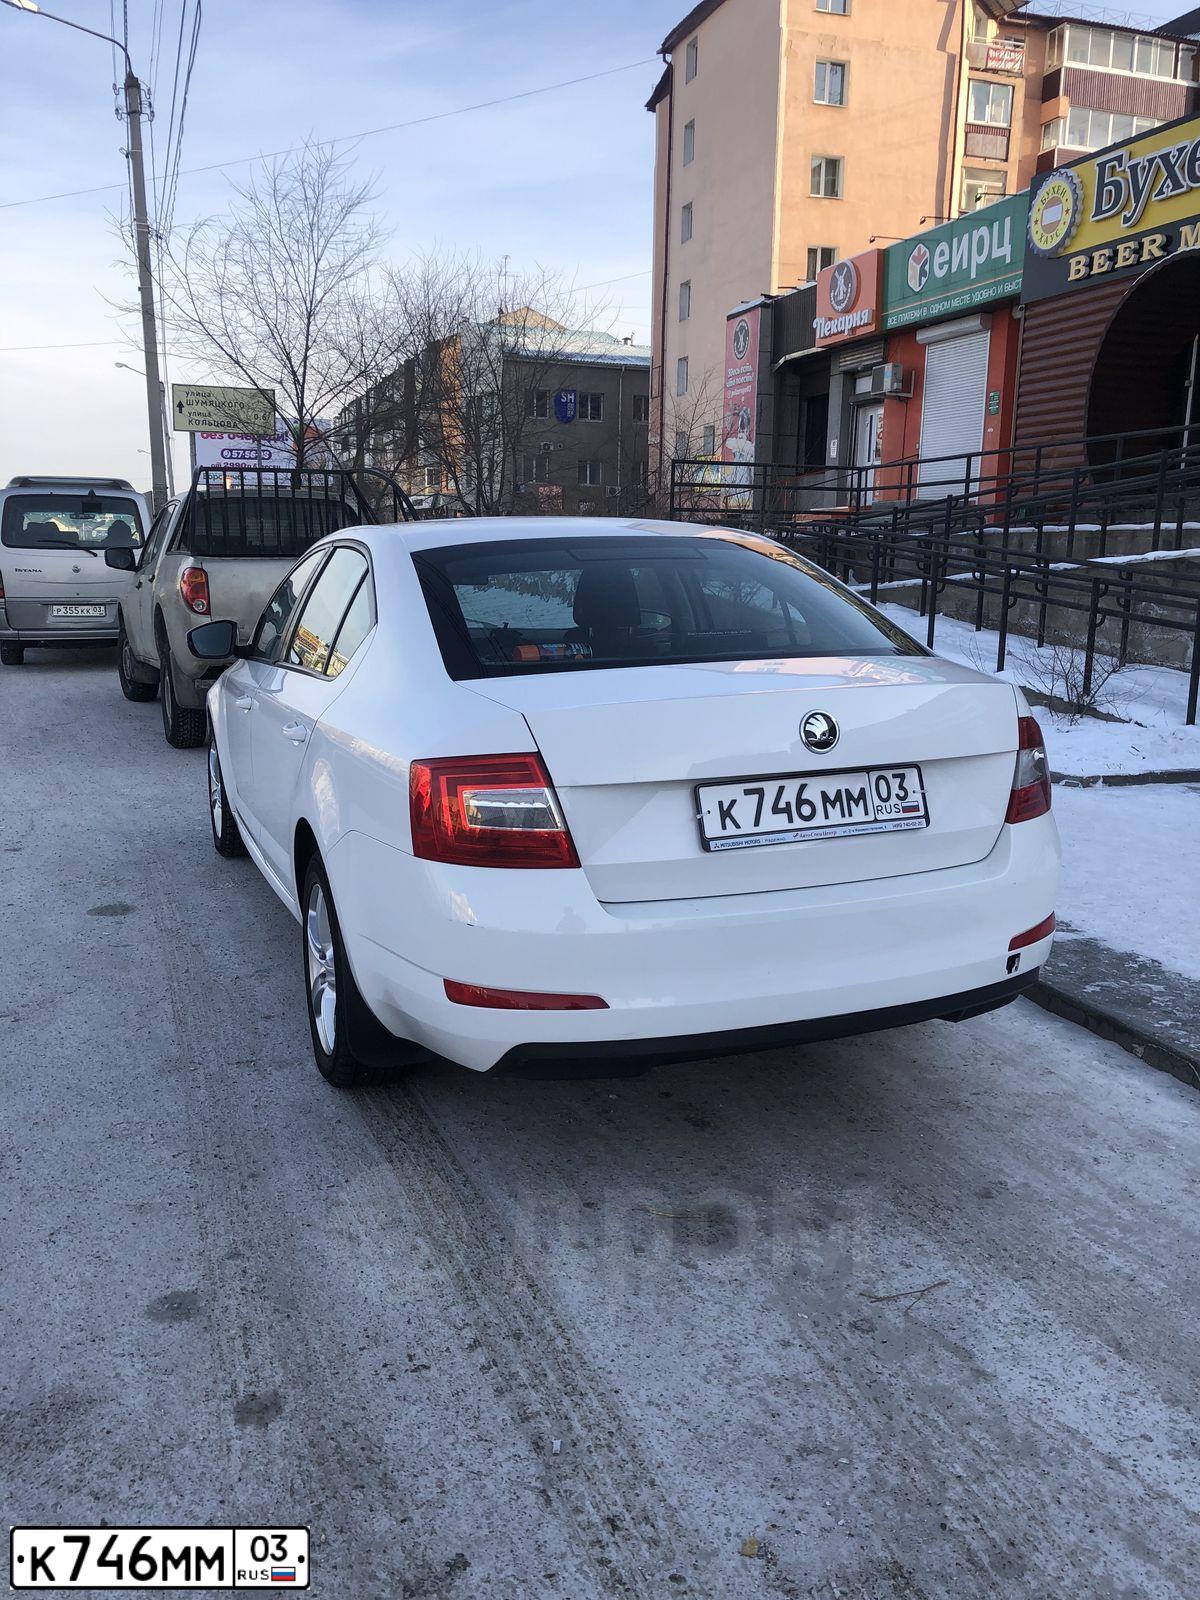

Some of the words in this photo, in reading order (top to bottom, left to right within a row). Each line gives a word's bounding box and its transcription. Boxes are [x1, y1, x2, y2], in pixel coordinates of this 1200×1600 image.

[933, 216, 1012, 280] еирц
[1039, 228, 1062, 246] ХАУС
[1067, 233, 1168, 282] BEER
[887, 316, 897, 326] ВСЕ
[930, 300, 951, 314] ОДНОМ
[951, 294, 971, 309] МЕСТЕ
[971, 286, 997, 302] УДОБНО
[997, 283, 1004, 294] И
[812, 309, 871, 339] Пекарня
[186, 399, 245, 409] ШУМЯЦКОГО
[188, 419, 239, 428] КОЛЬЦОВА
[874, 772, 909, 803] 03
[876, 803, 901, 816] RUS
